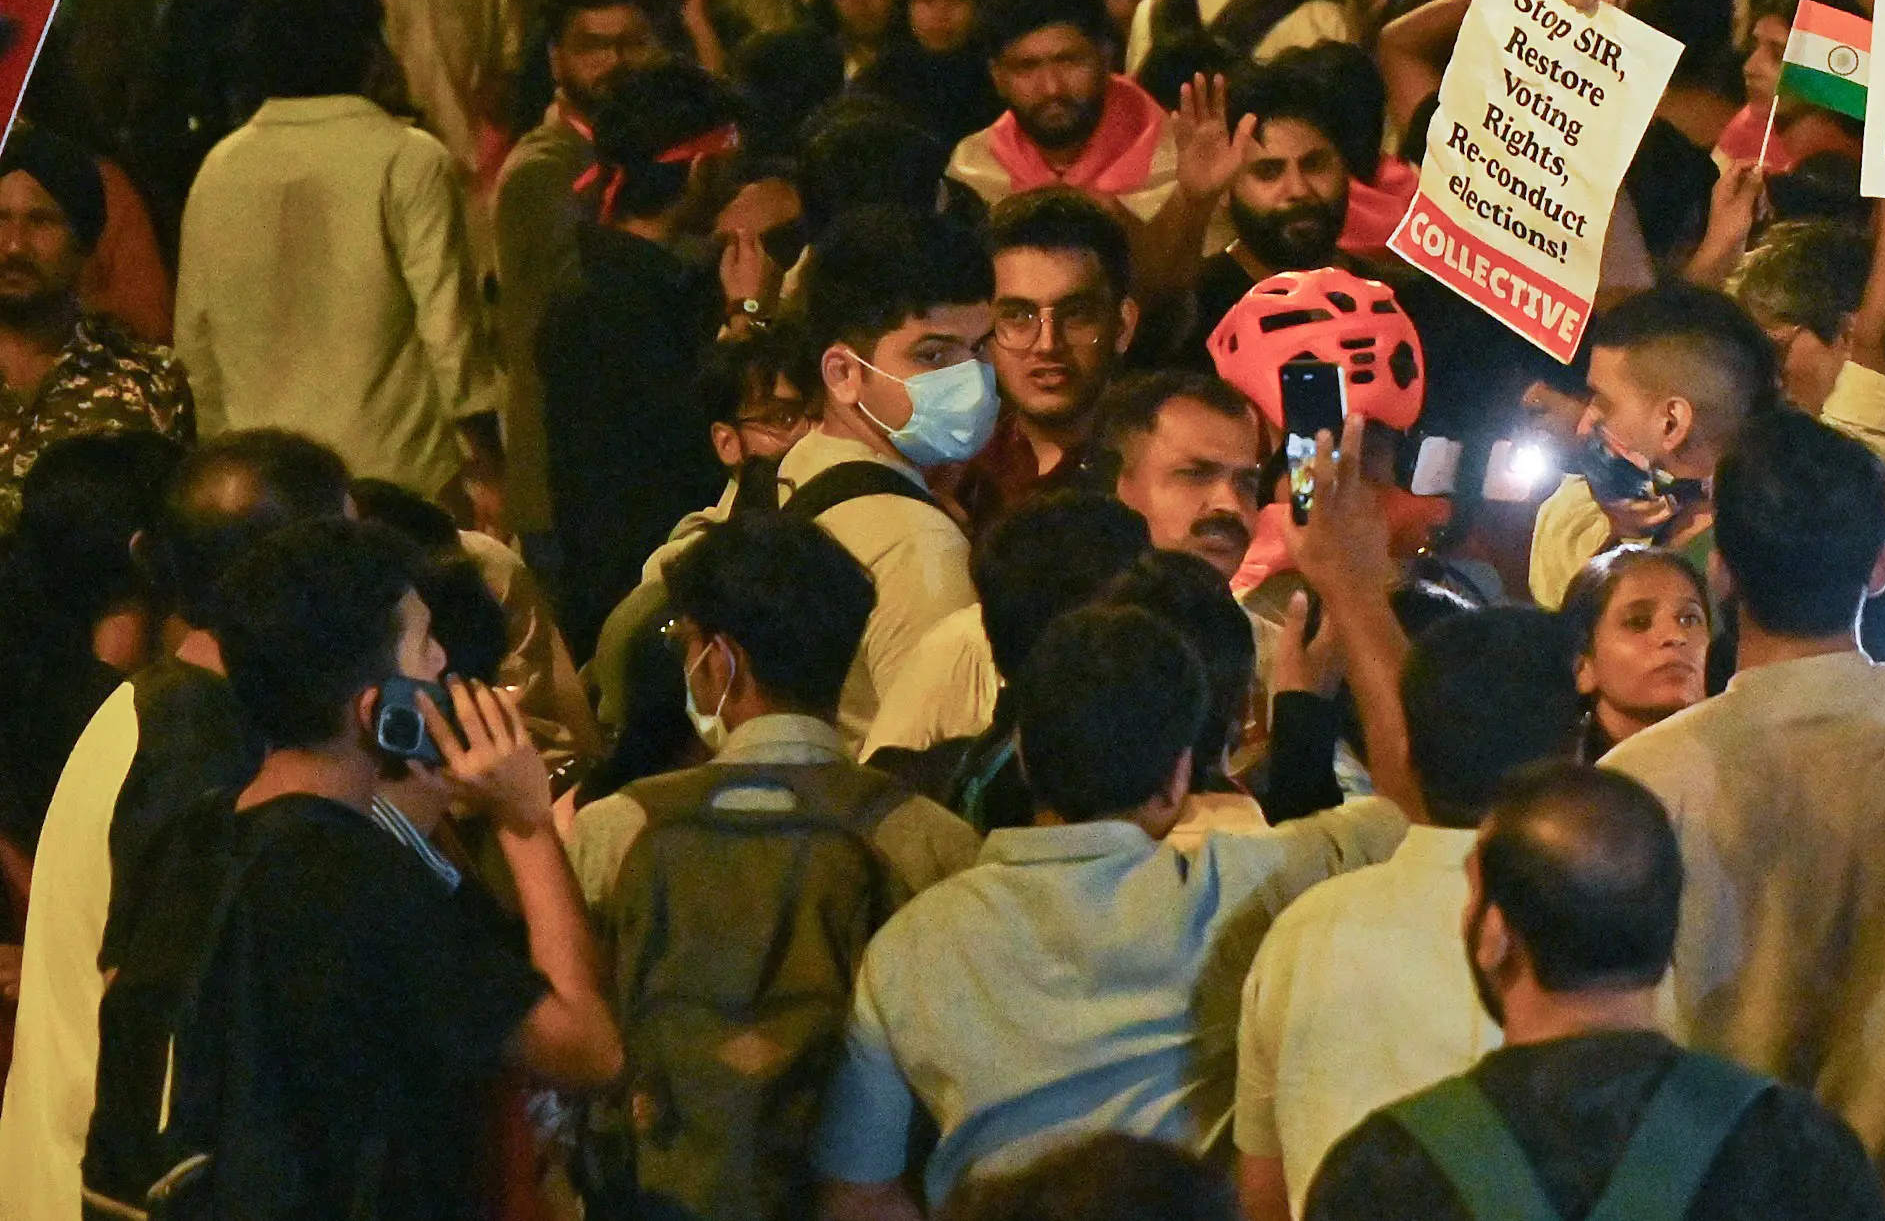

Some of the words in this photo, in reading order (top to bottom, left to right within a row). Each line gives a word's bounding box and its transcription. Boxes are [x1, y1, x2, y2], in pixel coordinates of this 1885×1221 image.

[1503, 25, 1606, 107] Restore
[1573, 27, 1626, 82] SIR,
[1482, 103, 1569, 187] Rights,
[1503, 67, 1584, 147] Voting
[1446, 121, 1588, 238] Re-conduct
[1448, 174, 1568, 264] elections!
[1409, 211, 1581, 344] COLLECTIVE
